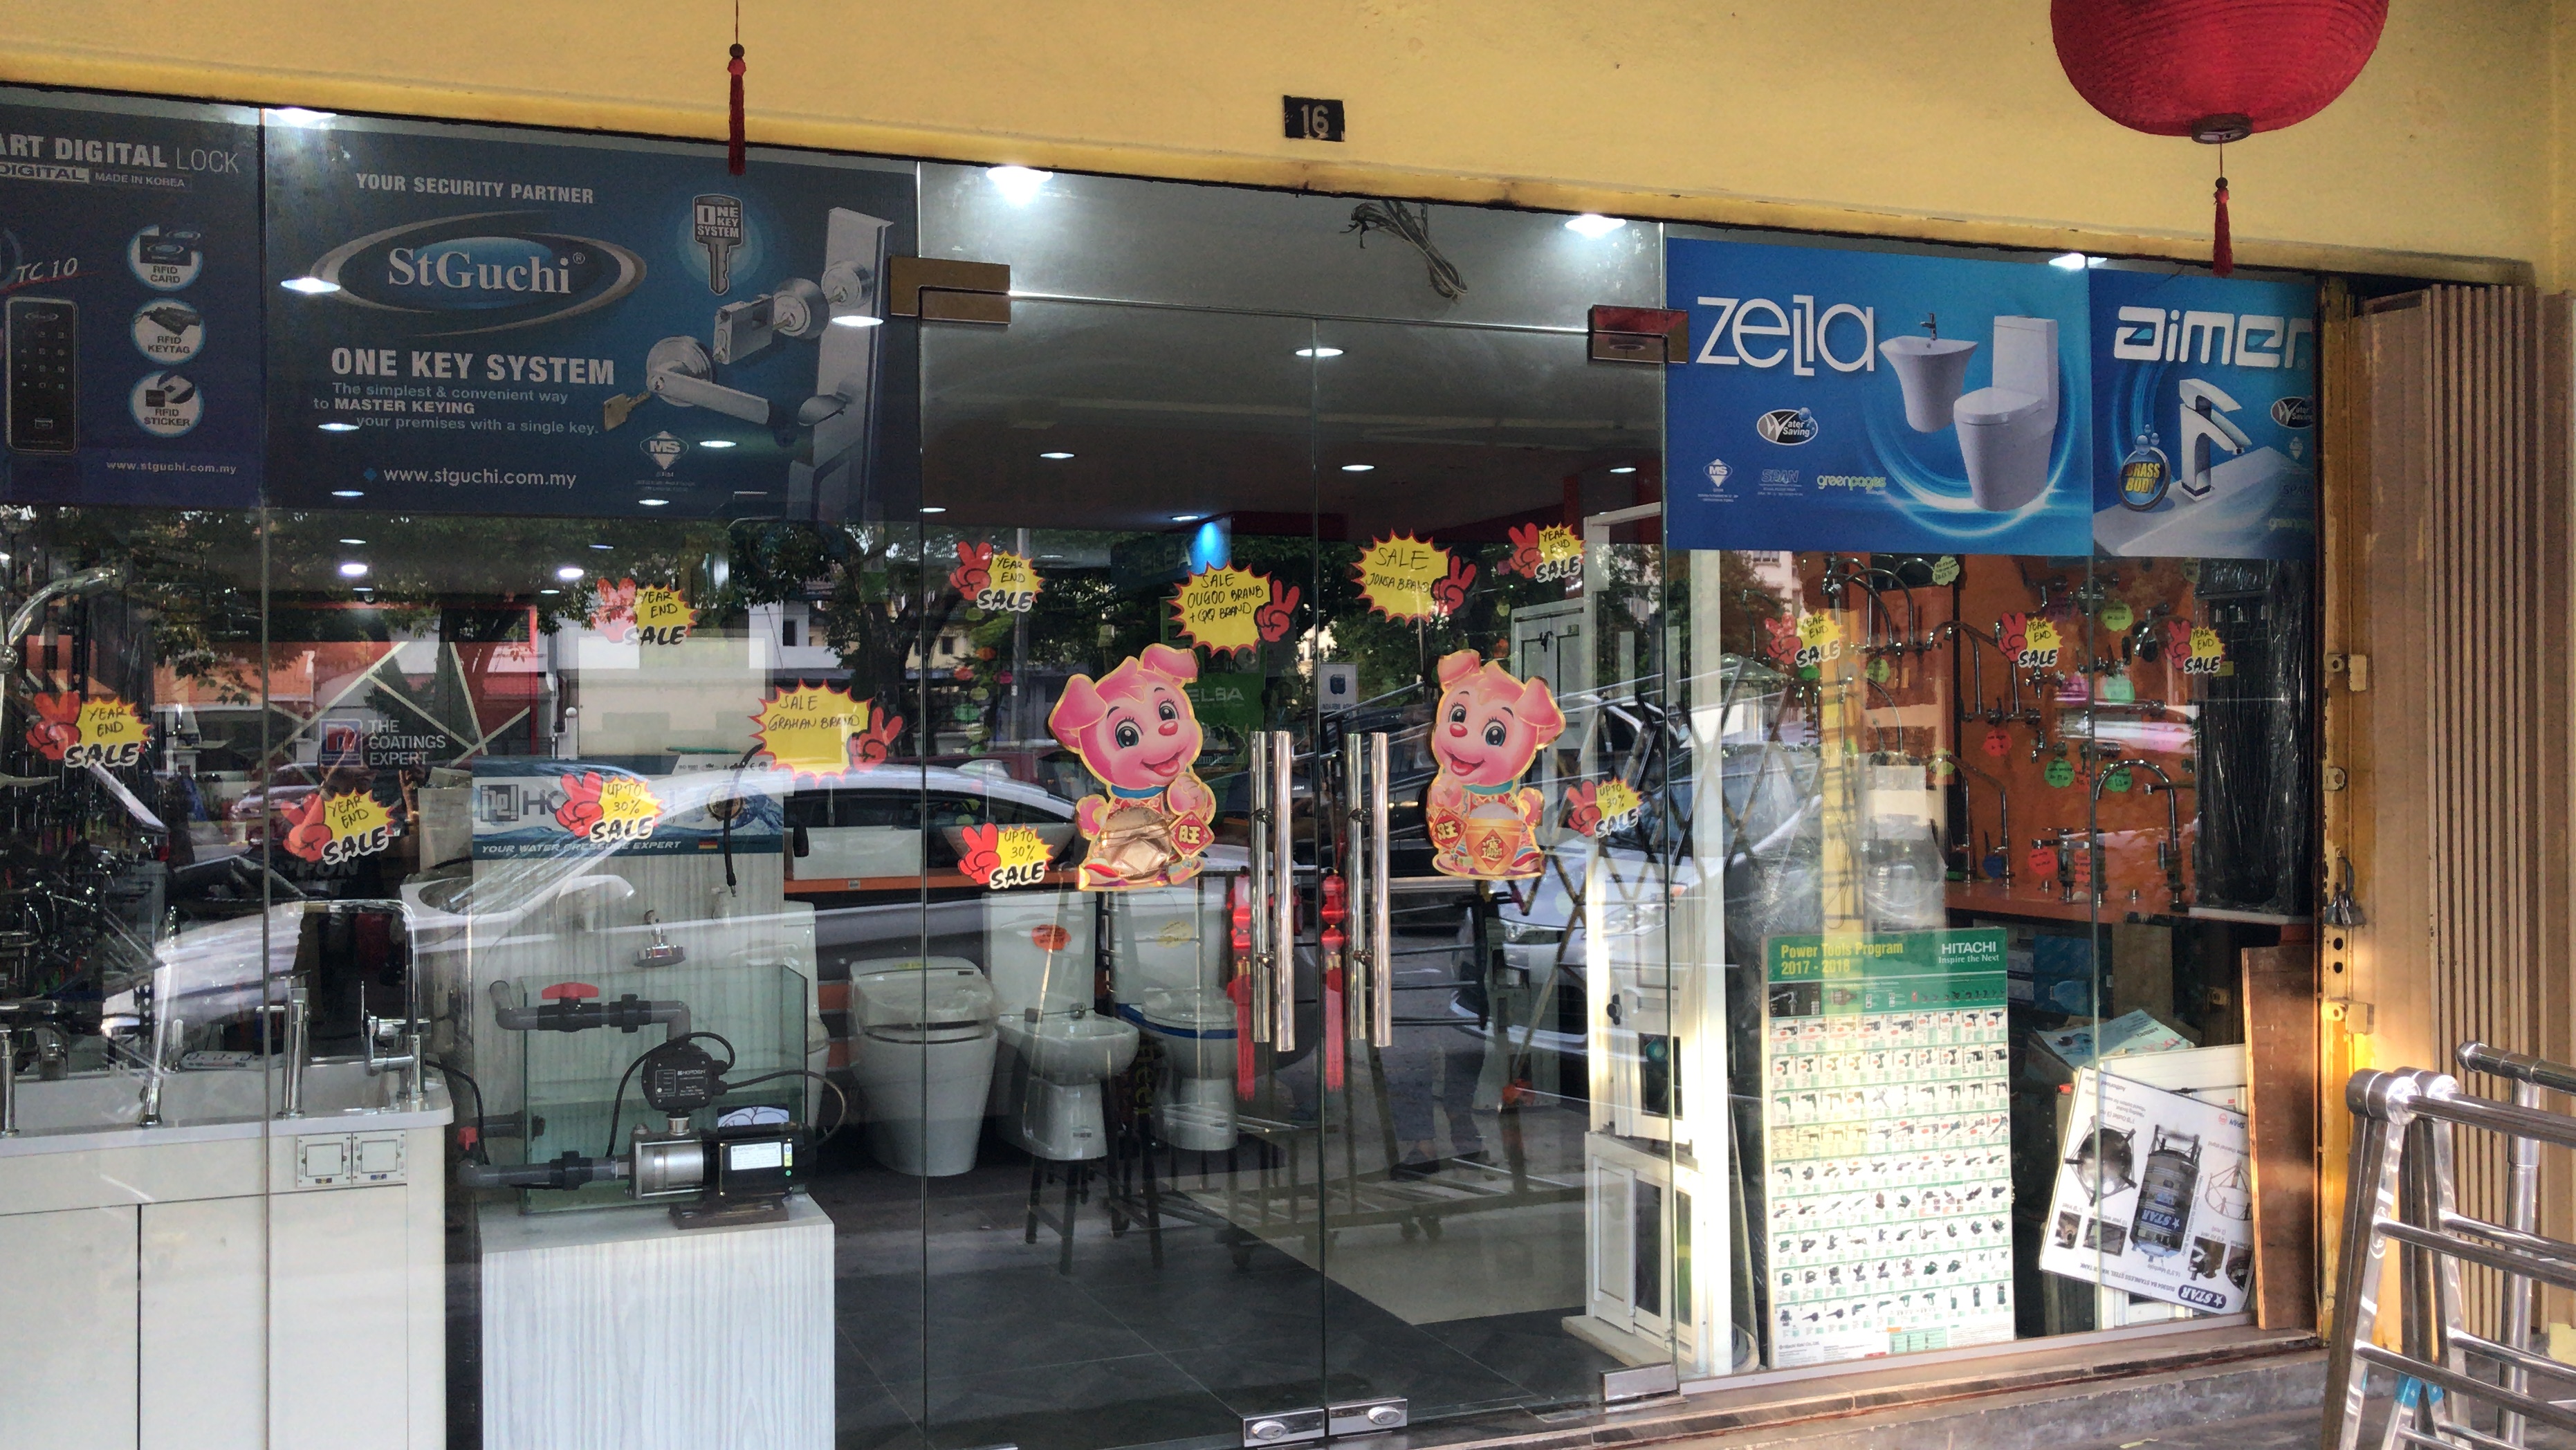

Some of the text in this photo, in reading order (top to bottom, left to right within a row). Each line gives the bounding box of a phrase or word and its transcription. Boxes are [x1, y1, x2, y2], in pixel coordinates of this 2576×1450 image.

[1301, 104, 1330, 135] 16
[55, 138, 168, 168] DIGITAL
[176, 147, 239, 174] LOCK
[95, 172, 128, 183] MADE
[131, 175, 143, 184] IN
[146, 176, 185, 188] KOREA
[356, 173, 594, 205] YOUR SECURITY PARTNER
[717, 217, 739, 227] KEY
[697, 225, 739, 238] SYSTEM
[153, 265, 178, 275] RFID
[388, 248, 572, 295] StGuchi
[149, 275, 181, 284] CARD
[157, 336, 182, 345] RFID
[147, 345, 190, 354] KEYTAG
[331, 347, 615, 385] ONE KEY SYSTEM
[332, 382, 569, 405] The simplest & convenient way
[155, 408, 180, 416] RFID
[313, 397, 475, 415] to MASTER KEYING
[143, 416, 190, 427] STICKER
[356, 416, 600, 437] your premises with a single key.
[1782, 426, 1810, 437] Saving
[650, 440, 681, 453] MS
[105, 461, 237, 475] www.stguchi.com.my
[1709, 466, 1728, 475] MS
[2126, 462, 2161, 479] BRASS
[384, 467, 577, 489] www.stguchi.com.my
[1816, 475, 1887, 490] greenpages
[2125, 476, 2158, 495] BODY
[1541, 529, 1567, 542] YEAR
[995, 556, 1025, 571] YEAR
[1374, 547, 1430, 571] SALE
[1536, 556, 1579, 580] SALE
[1000, 571, 1026, 585] END
[1201, 573, 1235, 589] SALE
[1397, 578, 1430, 594] BRAND
[642, 591, 672, 604] YEAR
[977, 589, 1033, 612] SALE
[651, 603, 678, 618] END
[1220, 601, 1252, 620] BRAND
[625, 625, 686, 646] SALE
[1809, 625, 1829, 639] END
[2026, 621, 2049, 634] YEAR
[2192, 629, 2211, 640] YEAR
[2034, 630, 2052, 642] END
[1796, 639, 1839, 666] SALE
[2197, 638, 2214, 651] END
[2018, 649, 2057, 666] SALE
[2184, 656, 2221, 672] SALE
[780, 695, 818, 711] SALE
[88, 706, 127, 722] YEAR
[820, 714, 861, 729] BRAND
[97, 720, 124, 737] END
[368, 719, 400, 733] THE
[368, 735, 446, 749] COATINGS
[65, 742, 139, 765] SALE
[369, 751, 429, 766] EXPERT
[607, 782, 642, 798] UP TO
[1599, 784, 1622, 796] UP TO
[328, 796, 362, 818] YEAR
[614, 799, 641, 815] 30%
[1606, 794, 1625, 809] 30%
[341, 809, 369, 829] END
[1595, 808, 1638, 837] SALE
[591, 816, 654, 840] SALE
[1179, 825, 1202, 844] 旺
[1437, 820, 1458, 840] 旺
[322, 826, 387, 862] SALE
[1004, 830, 1034, 843] UP TO
[482, 845, 515, 854] YOUR
[519, 843, 560, 852] WATER
[632, 840, 681, 850] EXPERT
[1011, 845, 1034, 861] 30%
[990, 861, 1045, 888] SALE
[1781, 941, 1904, 959] Power Tools Program
[1941, 941, 1997, 955] HITACHI
[1781, 960, 1810, 975] 2017
[1821, 958, 1851, 973] 2018
[1938, 954, 2000, 965] Inspire the Next
[2142, 1209, 2172, 1226] STAR
[2124, 1273, 2151, 1287] STAINLESS
[2180, 1286, 2214, 1305] STAR
